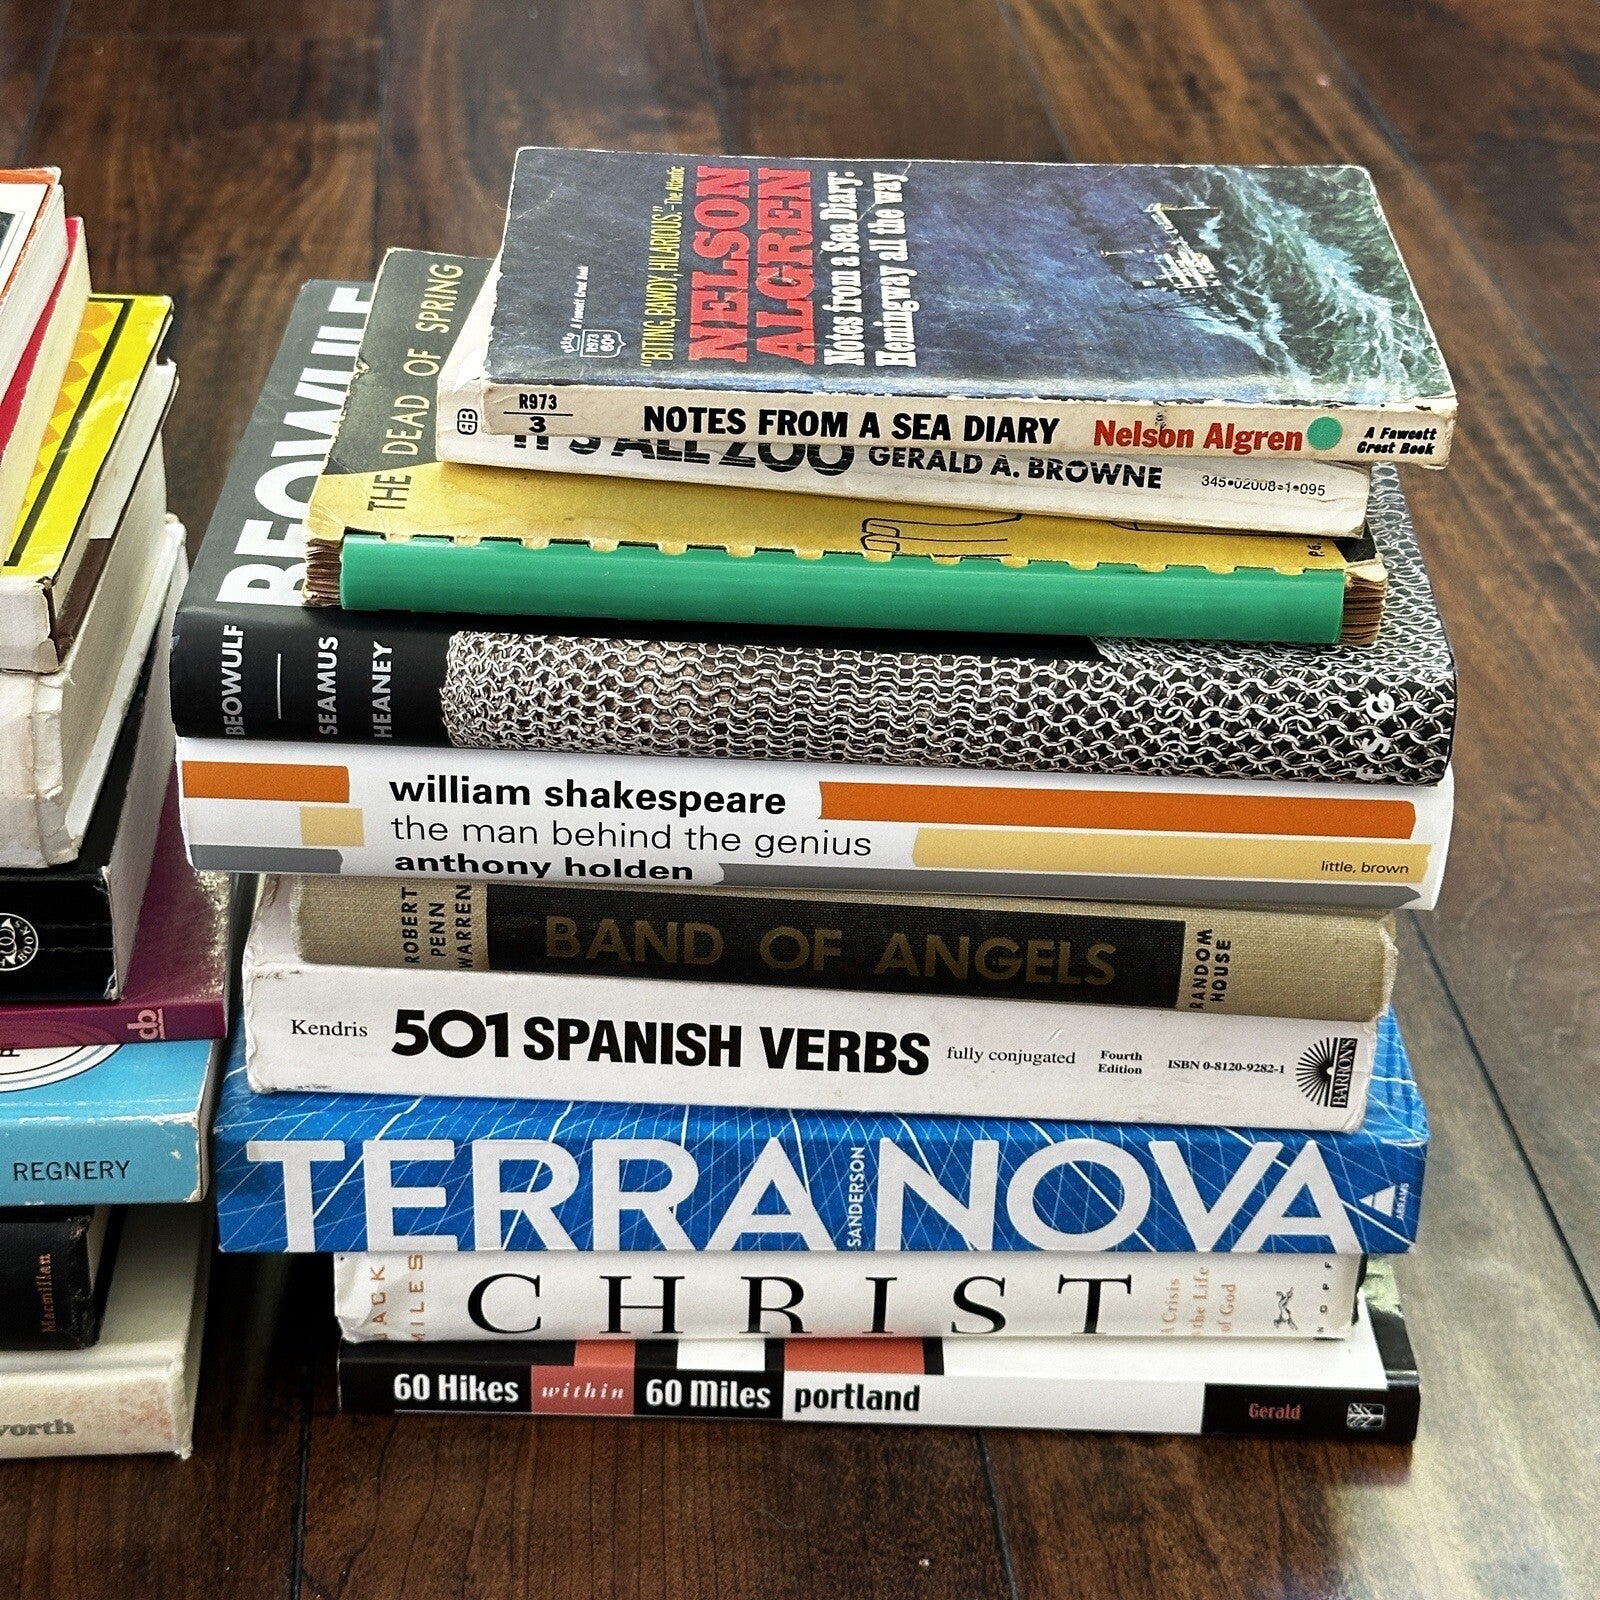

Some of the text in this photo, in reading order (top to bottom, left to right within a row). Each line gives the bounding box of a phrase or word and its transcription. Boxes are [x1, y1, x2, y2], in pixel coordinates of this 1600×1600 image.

[645, 273, 684, 316] BAWDY,
[665, 165, 686, 191] Atlantic
[688, 165, 750, 363] NELSON
[755, 167, 815, 366] ALGREN
[819, 171, 866, 366] Notes from a Sea Diary:
[867, 171, 920, 368] Hemingway all the way
[367, 263, 465, 511] THE DEAD OF SPRING
[519, 392, 558, 410] R973
[528, 416, 547, 434] 3
[643, 405, 1060, 445] NOTES FROM A SEA DIARY
[1093, 419, 1303, 456] Nelson Algren
[1356, 441, 1436, 456] Crest Book
[1363, 426, 1438, 441] A Fawcett
[867, 445, 1163, 490] GERALD A. BROWNE
[221, 624, 245, 736] BEOWULF
[317, 635, 339, 735] SEAMUS
[372, 640, 393, 738] HEANEY
[388, 774, 787, 818] william shakespeare
[391, 816, 873, 859] the man behind the genius
[393, 853, 694, 881] anthony holden
[1320, 860, 1410, 875] little, brown
[15, 919, 36, 963] BOOKS
[401, 886, 420, 964] ROBERT
[428, 902, 447, 957] PENN
[454, 884, 474, 969] WARREN
[545, 914, 1117, 987] BAND OF ANGELS
[1189, 928, 1213, 1010] RANDOM
[1209, 939, 1232, 1002] HOUSE
[290, 1018, 369, 1039] Kendris
[391, 1008, 931, 1077] 501 SPANISH VERBS
[946, 1045, 1077, 1066] fully conjugated
[1098, 1062, 1143, 1075] Edition
[1100, 1049, 1143, 1062] Fourth
[1167, 1058, 1286, 1075] ISBN 0-8120-9282-1
[1331, 1039, 1356, 1106] BARRON'S
[13, 1160, 131, 1181] REGNERY
[246, 1136, 1361, 1252] TERRA NOVA
[846, 1147, 866, 1248] SANDERSON
[36, 1252, 56, 1334] Macmillan
[467, 1272, 1133, 1335] CHRIST
[1161, 1278, 1181, 1323] Crisis
[1192, 1266, 1210, 1300] Life
[1216, 1282, 1237, 1333] of God
[393, 1373, 921, 1413] 60 Hikes within 60 Miles portland
[1248, 1402, 1301, 1420] Gerald
